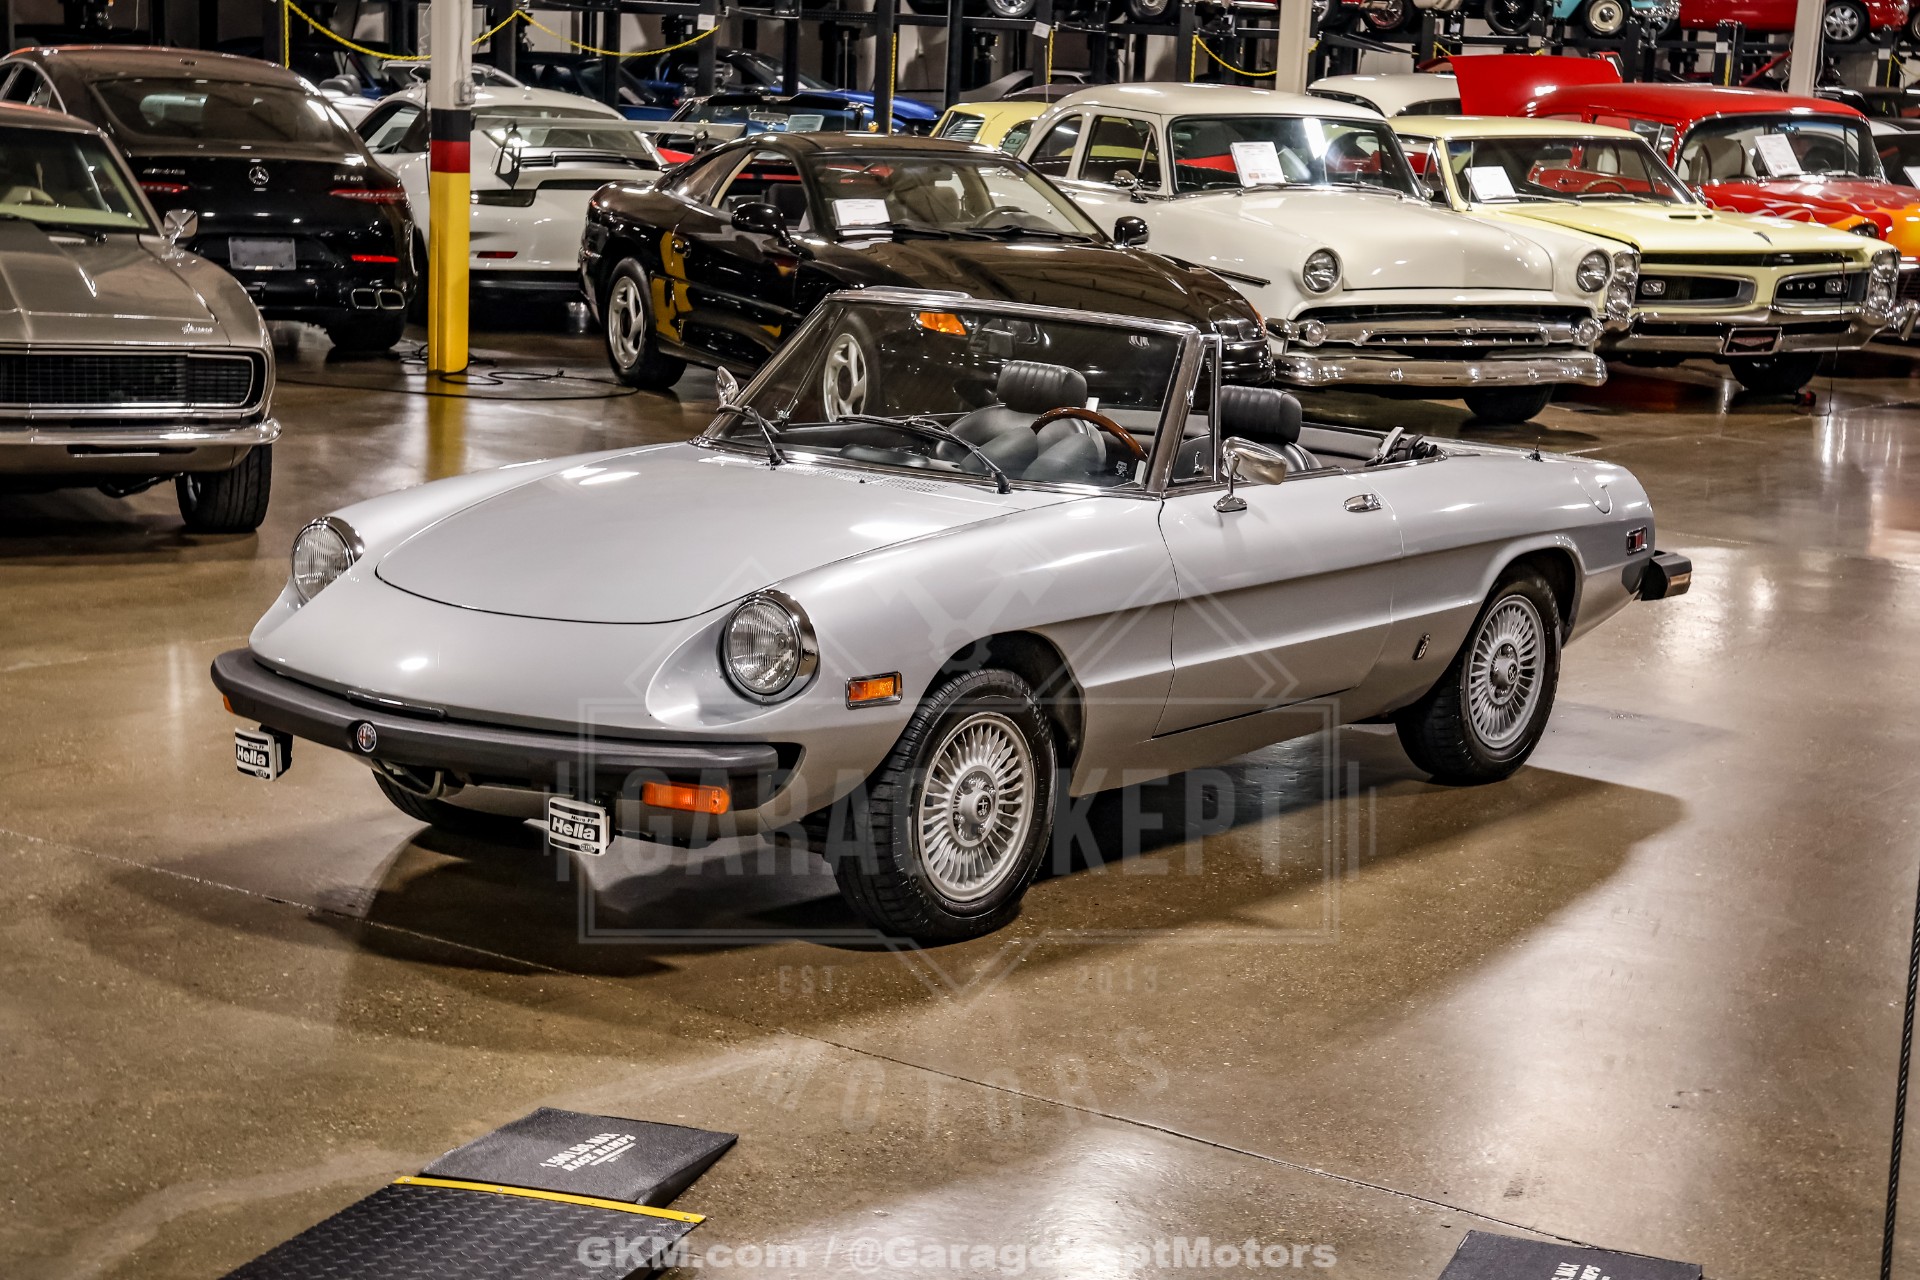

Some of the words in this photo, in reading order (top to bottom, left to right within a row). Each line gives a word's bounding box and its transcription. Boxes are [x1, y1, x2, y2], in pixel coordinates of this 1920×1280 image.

[552, 816, 596, 840] Hella
[562, 1153, 598, 1171] RACE
[592, 1134, 636, 1155] RAMPS
